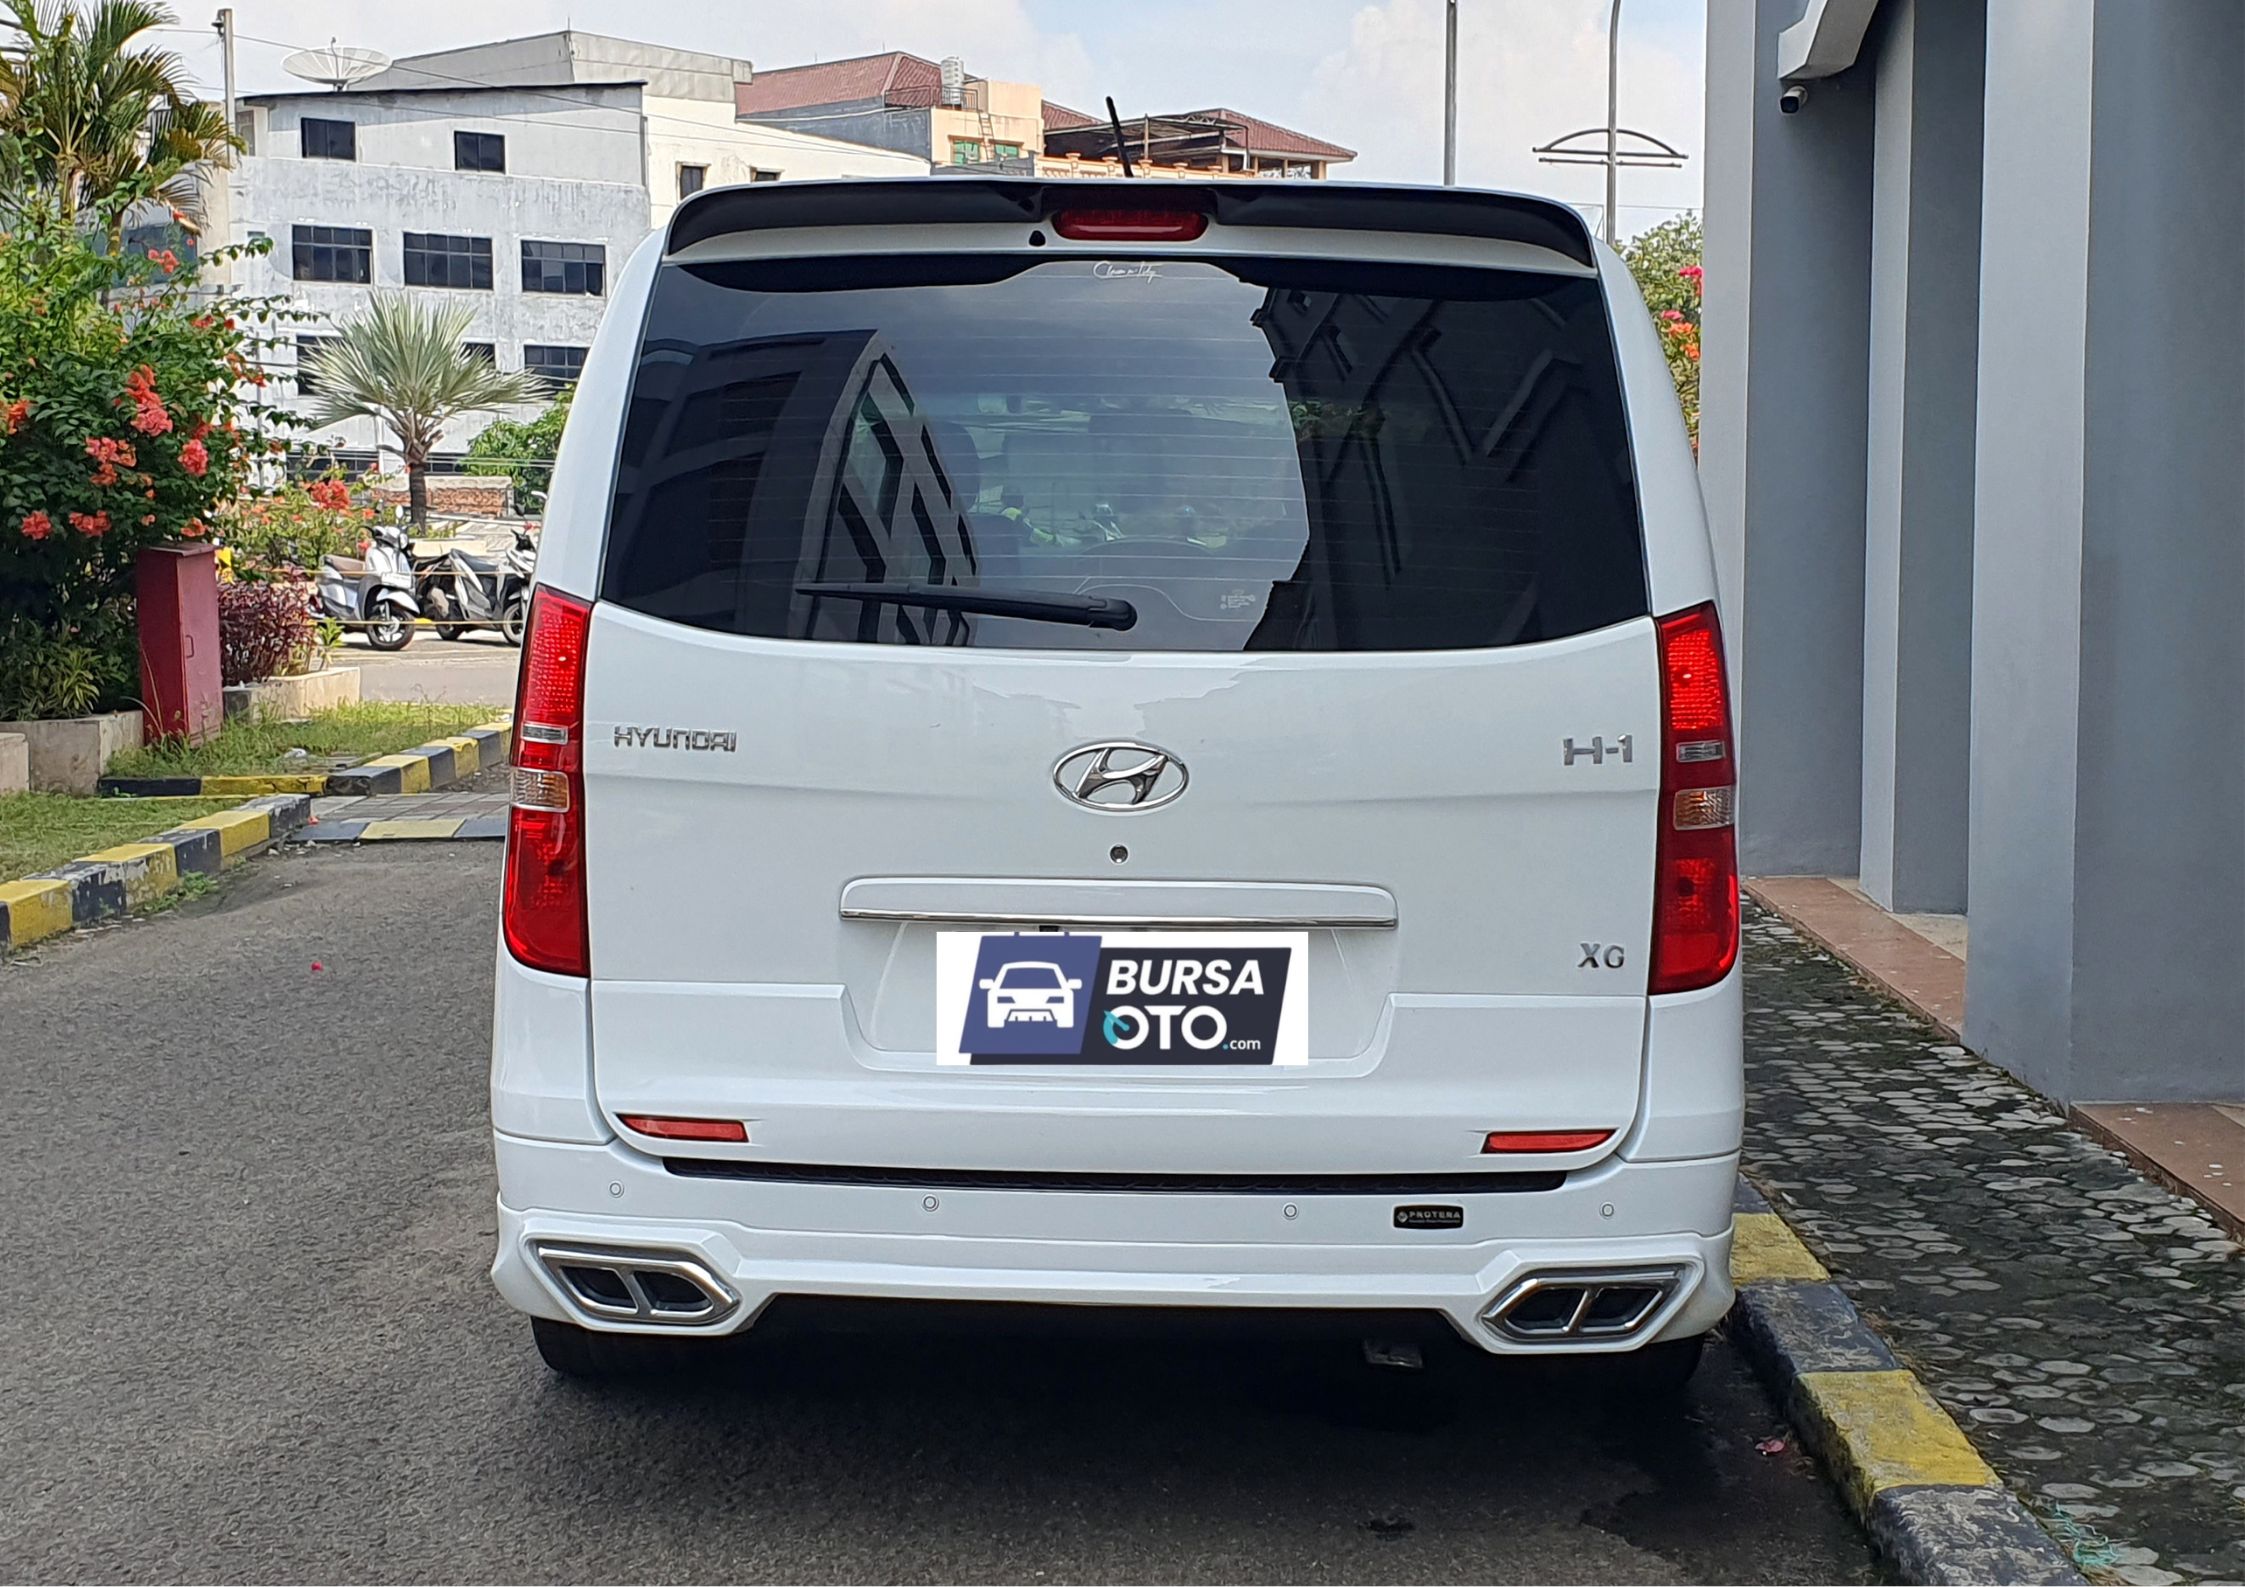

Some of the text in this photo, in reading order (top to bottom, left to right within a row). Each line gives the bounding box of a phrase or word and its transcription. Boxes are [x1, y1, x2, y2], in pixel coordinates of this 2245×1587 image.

[614, 726, 737, 752] HYUNDAI
[1563, 734, 1632, 765] H-1
[1578, 943, 1624, 968] XG
